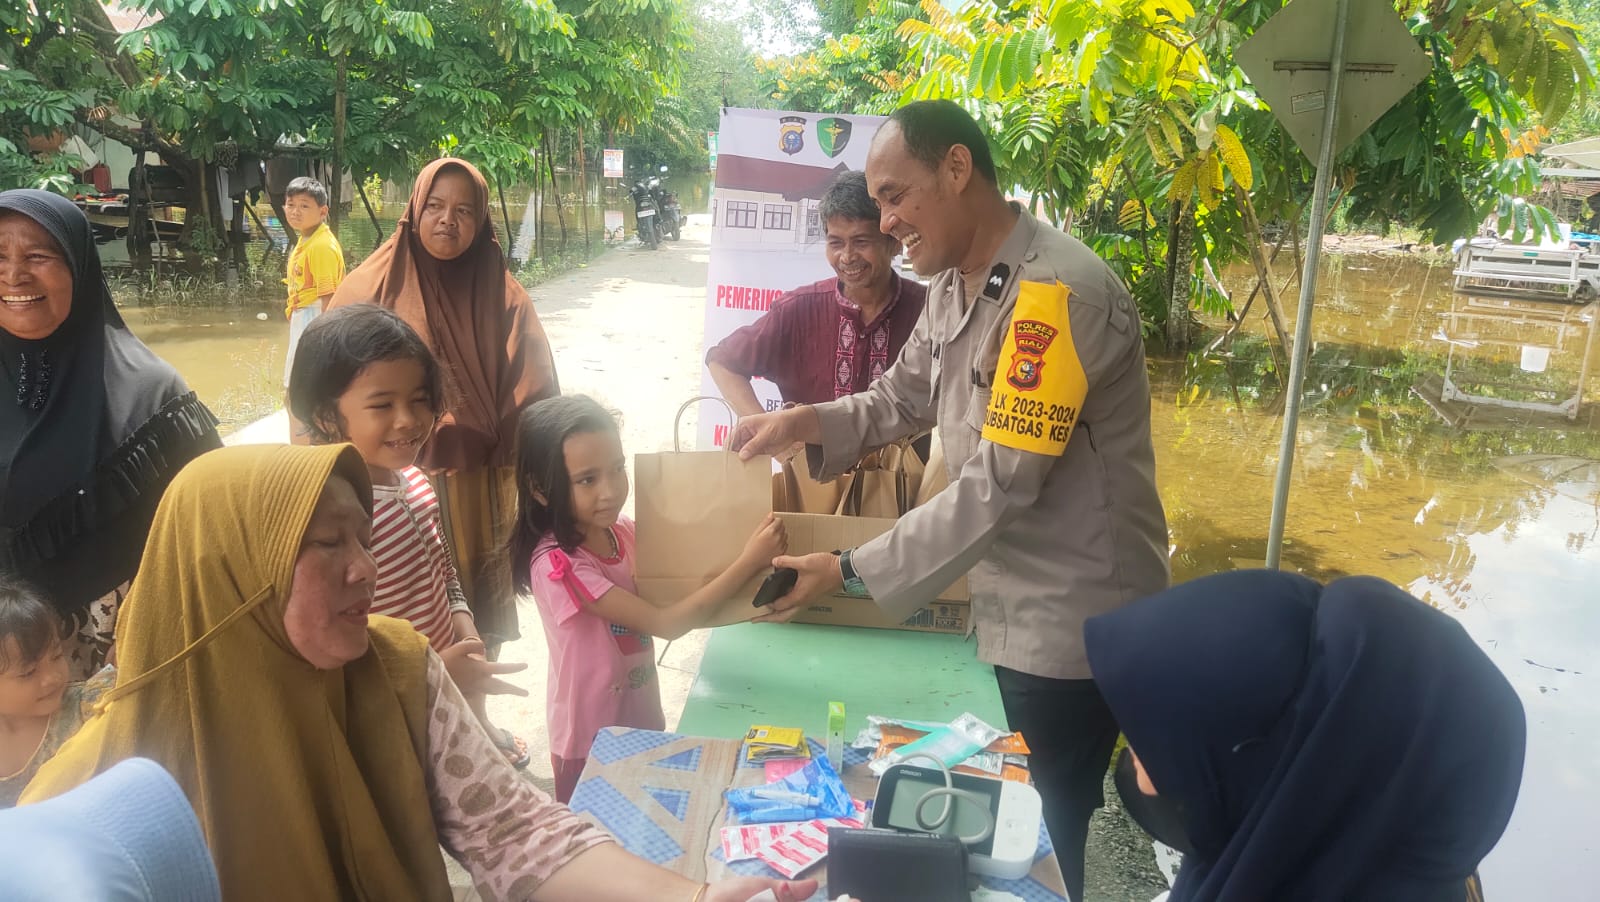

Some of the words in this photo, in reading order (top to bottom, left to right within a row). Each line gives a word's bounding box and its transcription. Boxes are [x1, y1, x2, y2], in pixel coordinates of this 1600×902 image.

[1017, 322, 1054, 336] POLRES
[1018, 339, 1044, 349] RIAU
[994, 391, 1008, 410] LK
[1011, 396, 1076, 424] 2023-2024
[1049, 424, 1070, 443] KES
